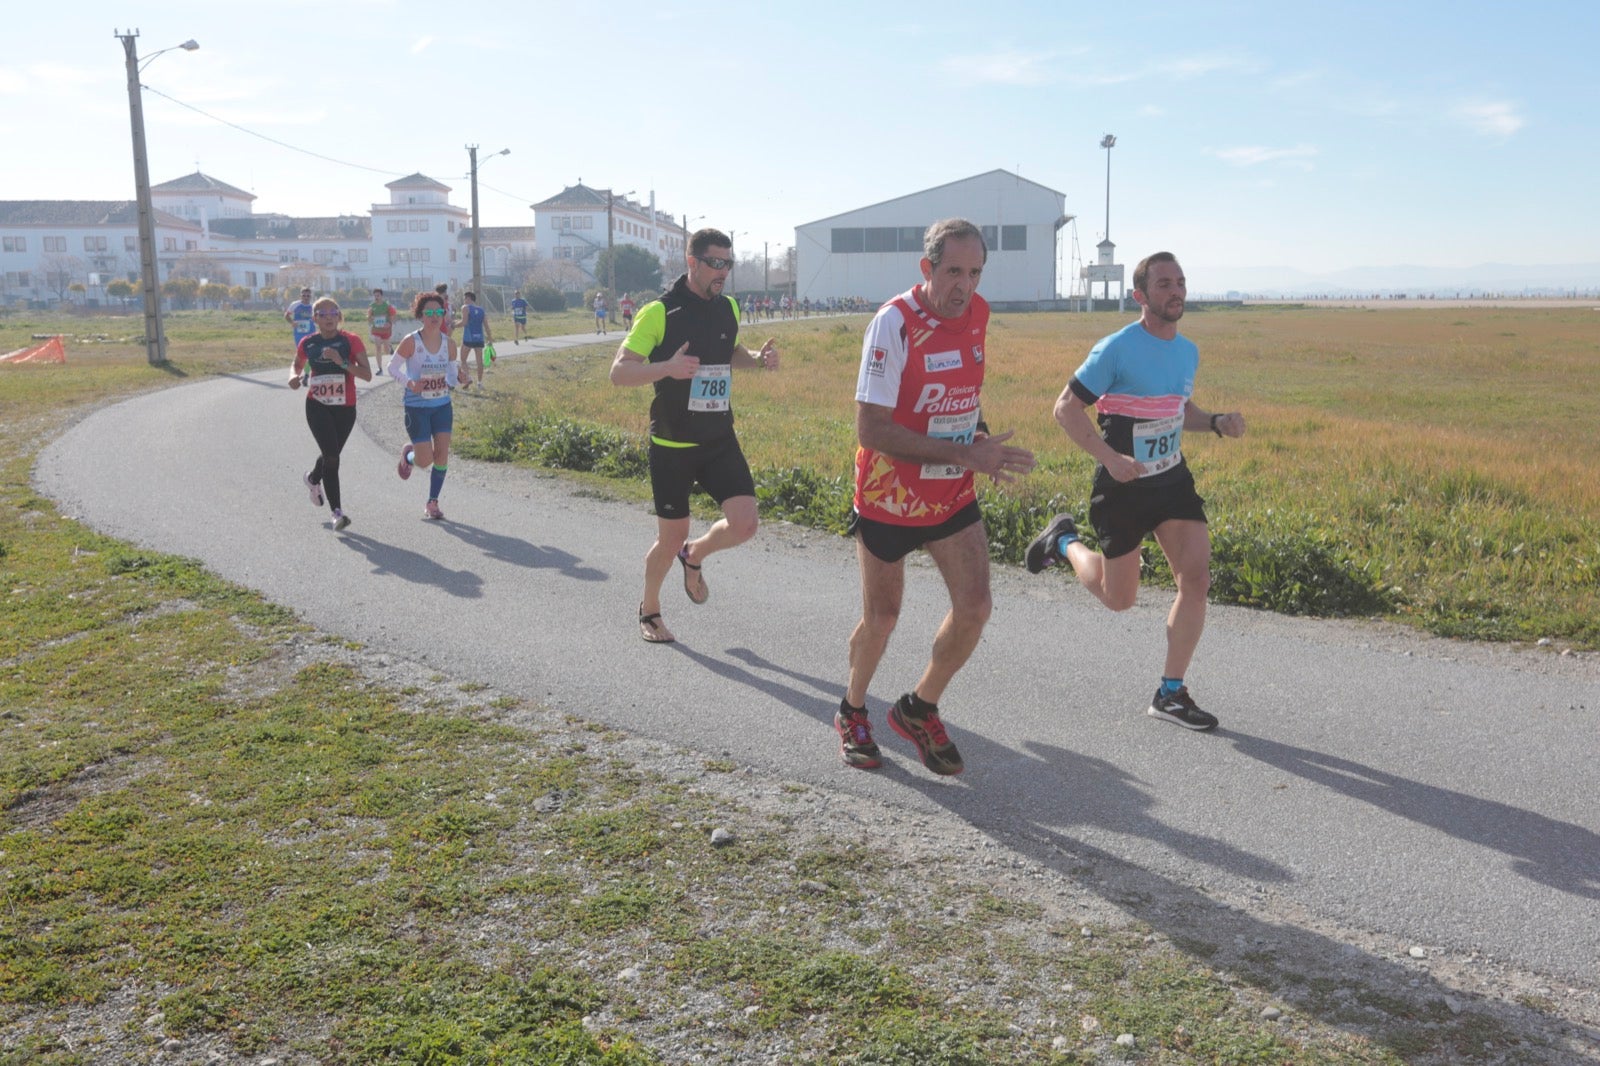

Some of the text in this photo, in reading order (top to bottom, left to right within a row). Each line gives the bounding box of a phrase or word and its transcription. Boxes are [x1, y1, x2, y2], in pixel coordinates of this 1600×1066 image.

[313, 383, 344, 396] 2014
[701, 379, 726, 396] 788
[1144, 432, 1177, 457] 787
